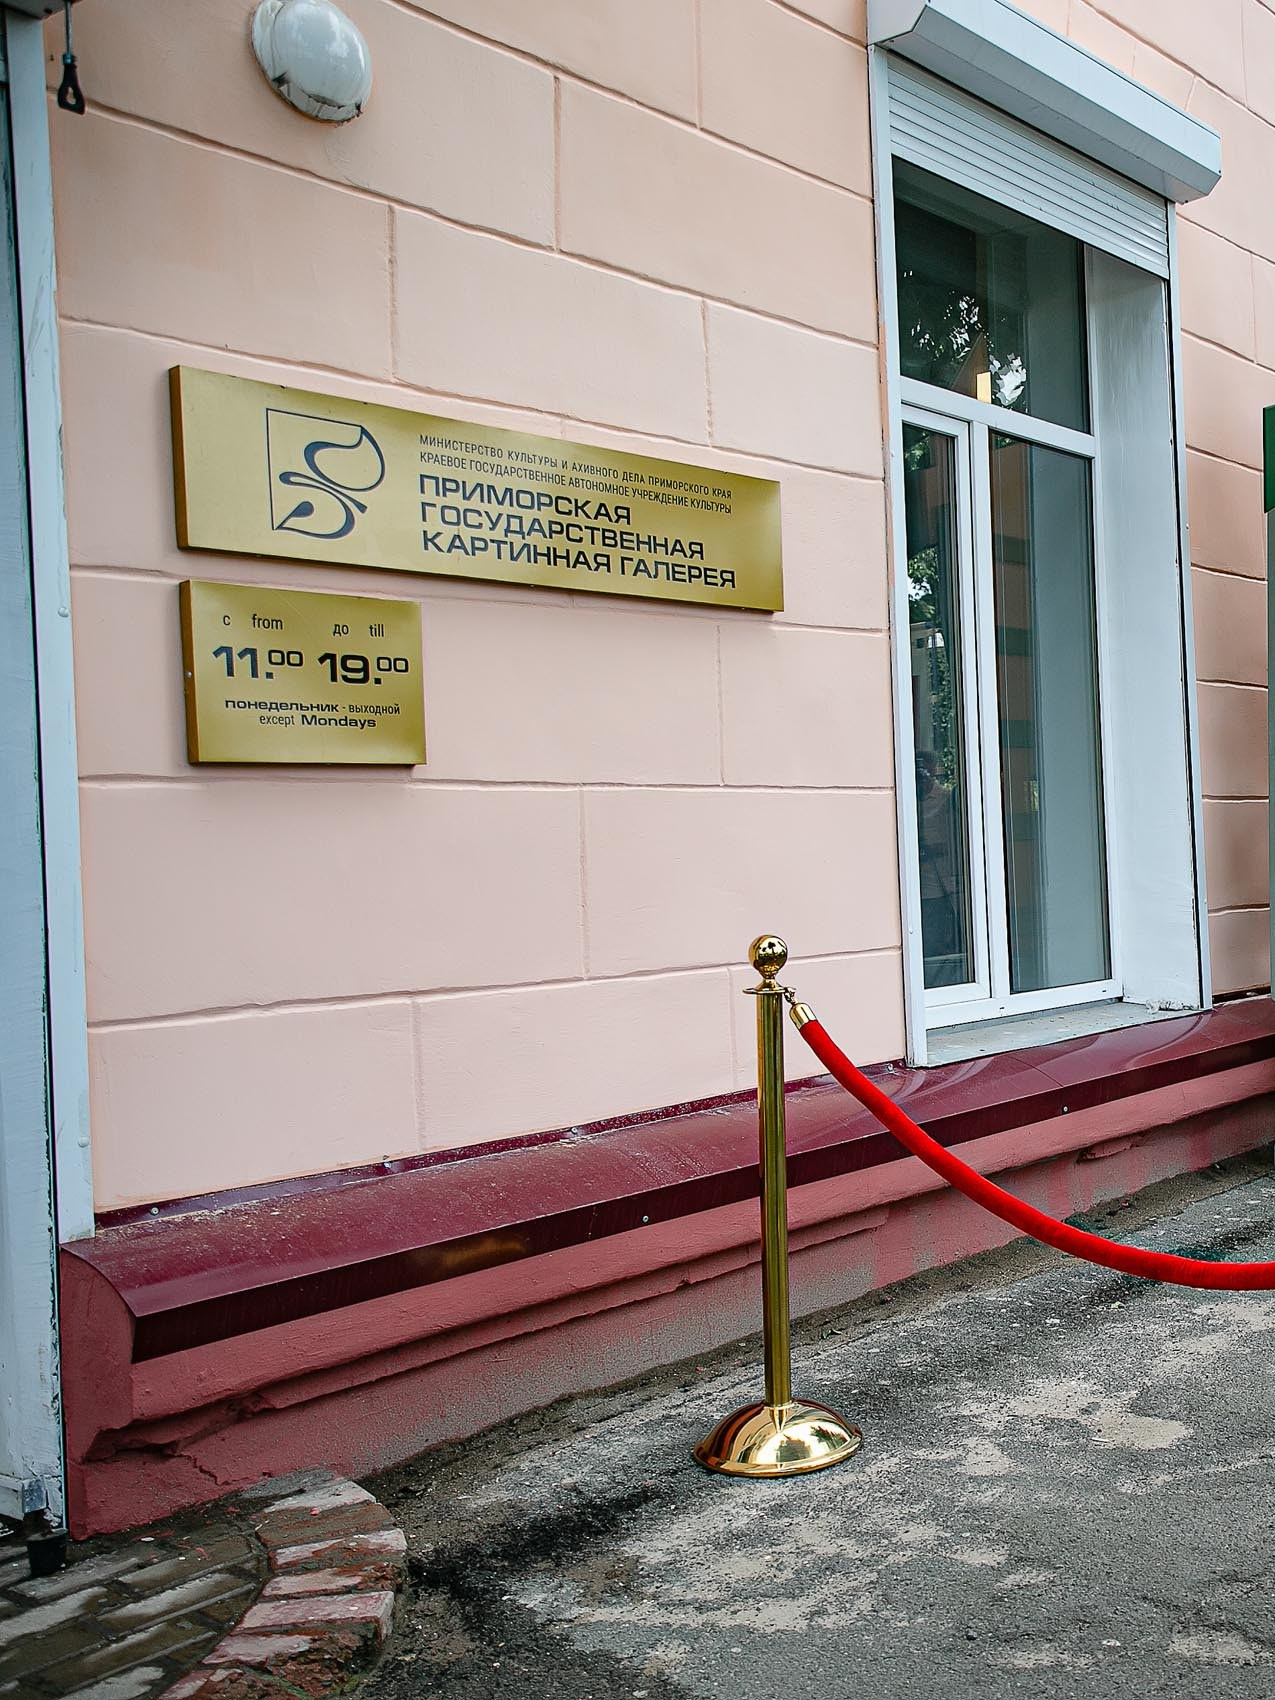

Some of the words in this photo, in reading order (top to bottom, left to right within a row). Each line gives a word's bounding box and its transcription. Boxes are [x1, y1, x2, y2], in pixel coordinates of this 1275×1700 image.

[419, 434, 503, 459] МИНИСТЕРСТВО
[507, 450, 558, 468] КУЛЬТУРЫ
[561, 460, 568, 470] И
[571, 462, 618, 479] АХИВНОГО
[622, 471, 645, 484] ДЕЛА
[648, 475, 709, 496] ПРИМОРСКОГО
[712, 488, 732, 499] КРАЯ
[420, 452, 467, 470] КРАЕВОЕ
[469, 460, 566, 486] ГОСУДАРСТВЕННОЕ
[568, 476, 630, 497] АВТОНОМНОЕ
[631, 487, 689, 507] УЧРЕЖДЕНИЕ
[690, 499, 732, 514] КУЛЬТУРЫ
[419, 474, 631, 525] ПРИМОРСКАЯ
[421, 502, 705, 561] ГОСУДАРСТВЕННАЯ
[422, 531, 612, 574] КАРТИННАЯ
[620, 556, 737, 589] ГАЛЕРЕЯ
[252, 613, 283, 630] from
[333, 623, 349, 636] до
[369, 624, 384, 637] till
[225, 699, 339, 712] понедельник
[348, 703, 400, 715] выходной
[259, 714, 295, 727] except
[301, 715, 377, 730] Mondays
